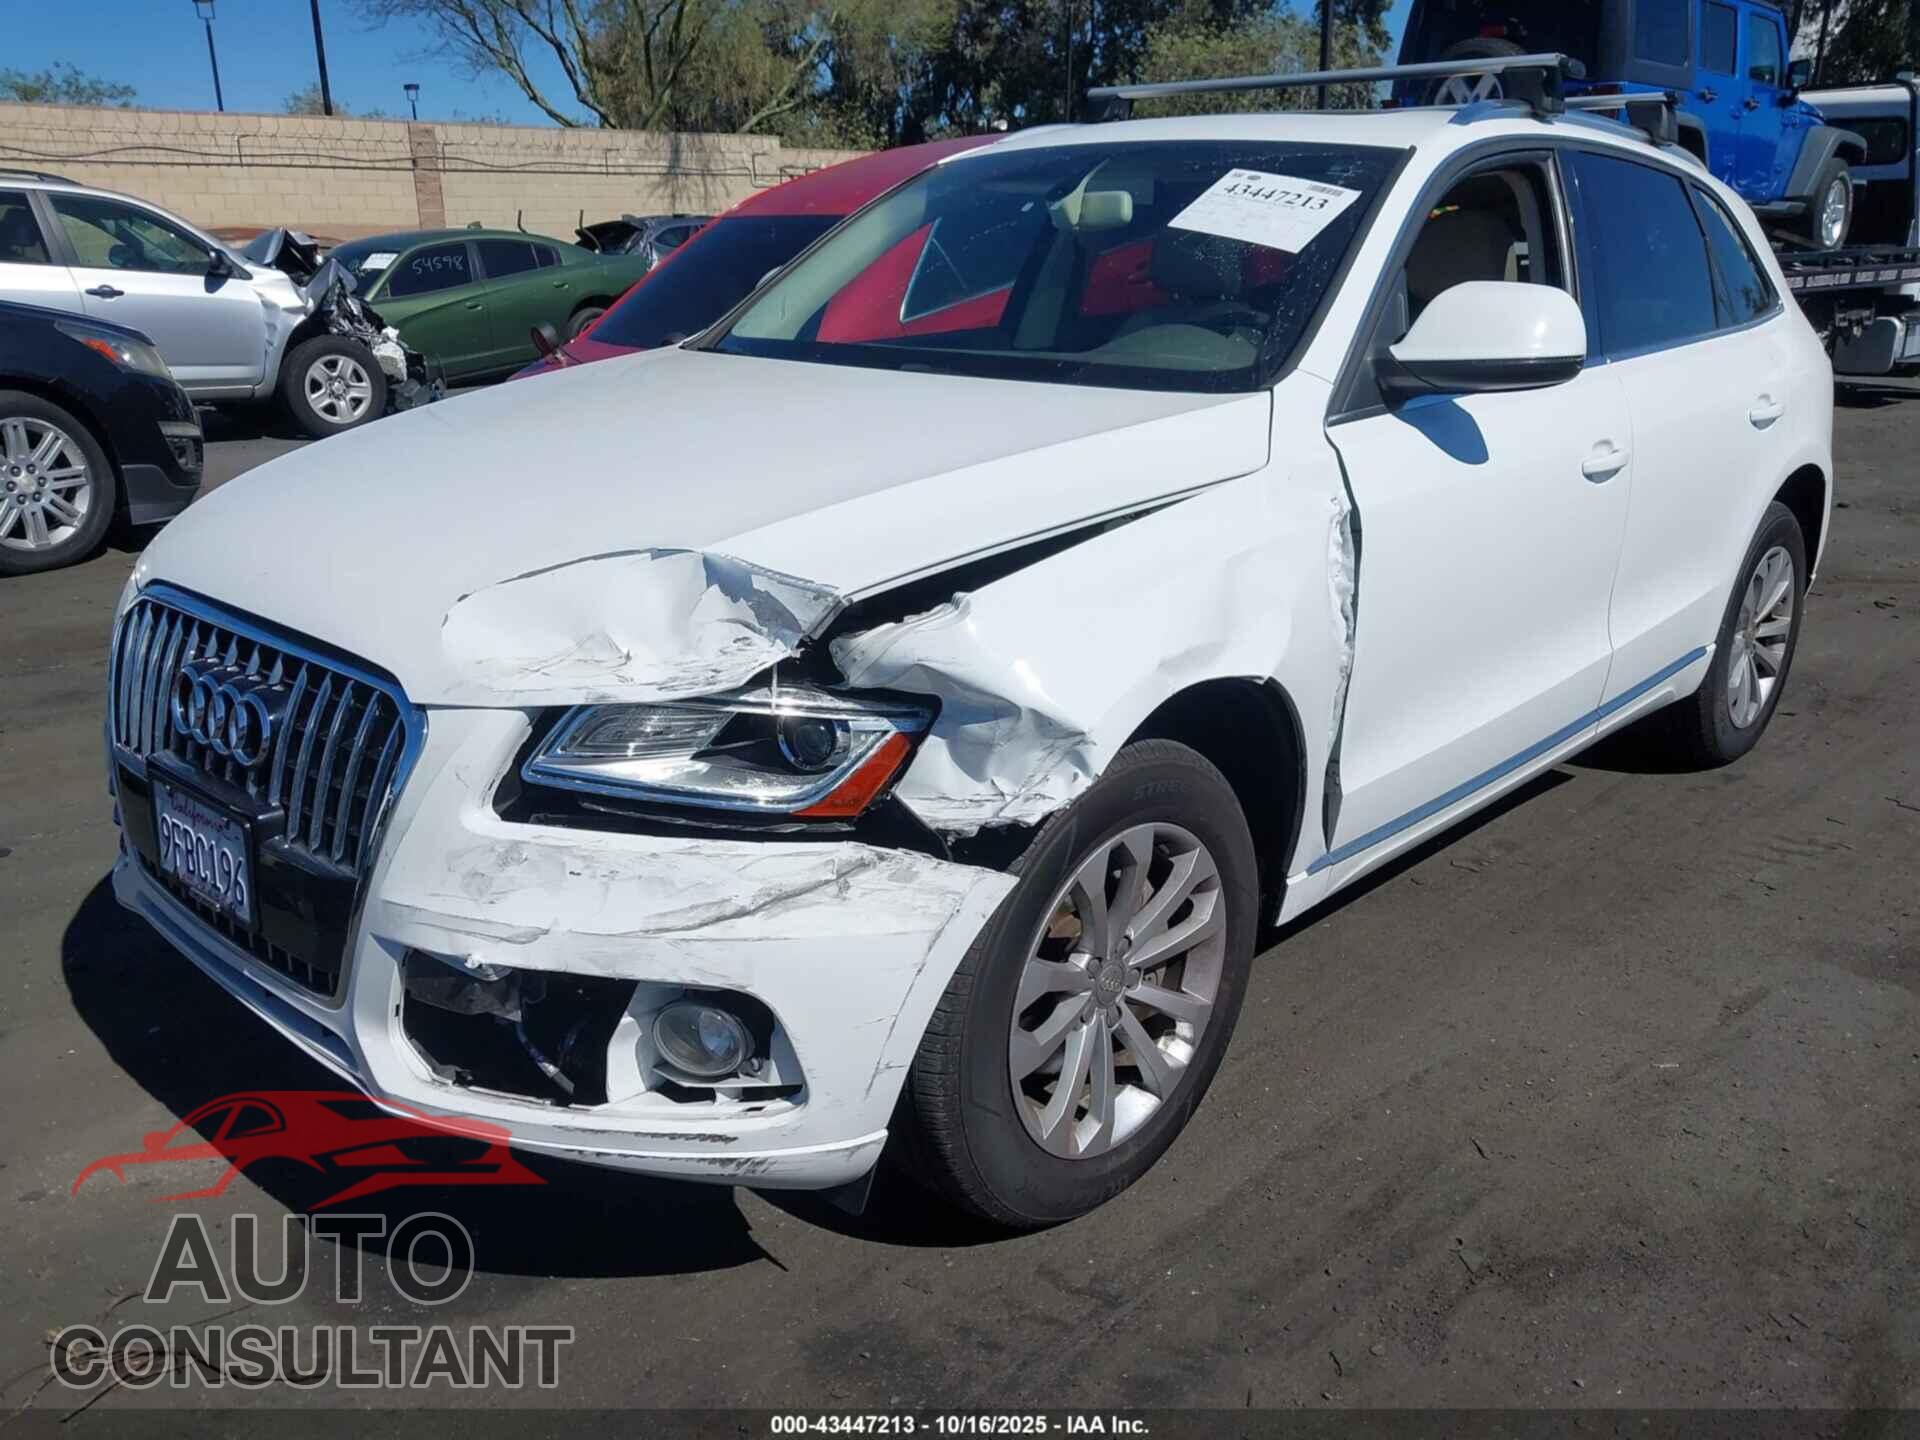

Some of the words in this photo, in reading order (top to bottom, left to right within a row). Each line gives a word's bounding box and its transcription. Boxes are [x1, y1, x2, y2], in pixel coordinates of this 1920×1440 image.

[1224, 183, 1329, 211] 43447213
[412, 255, 464, 275] 54598
[161, 812, 248, 907] 9FBC196
